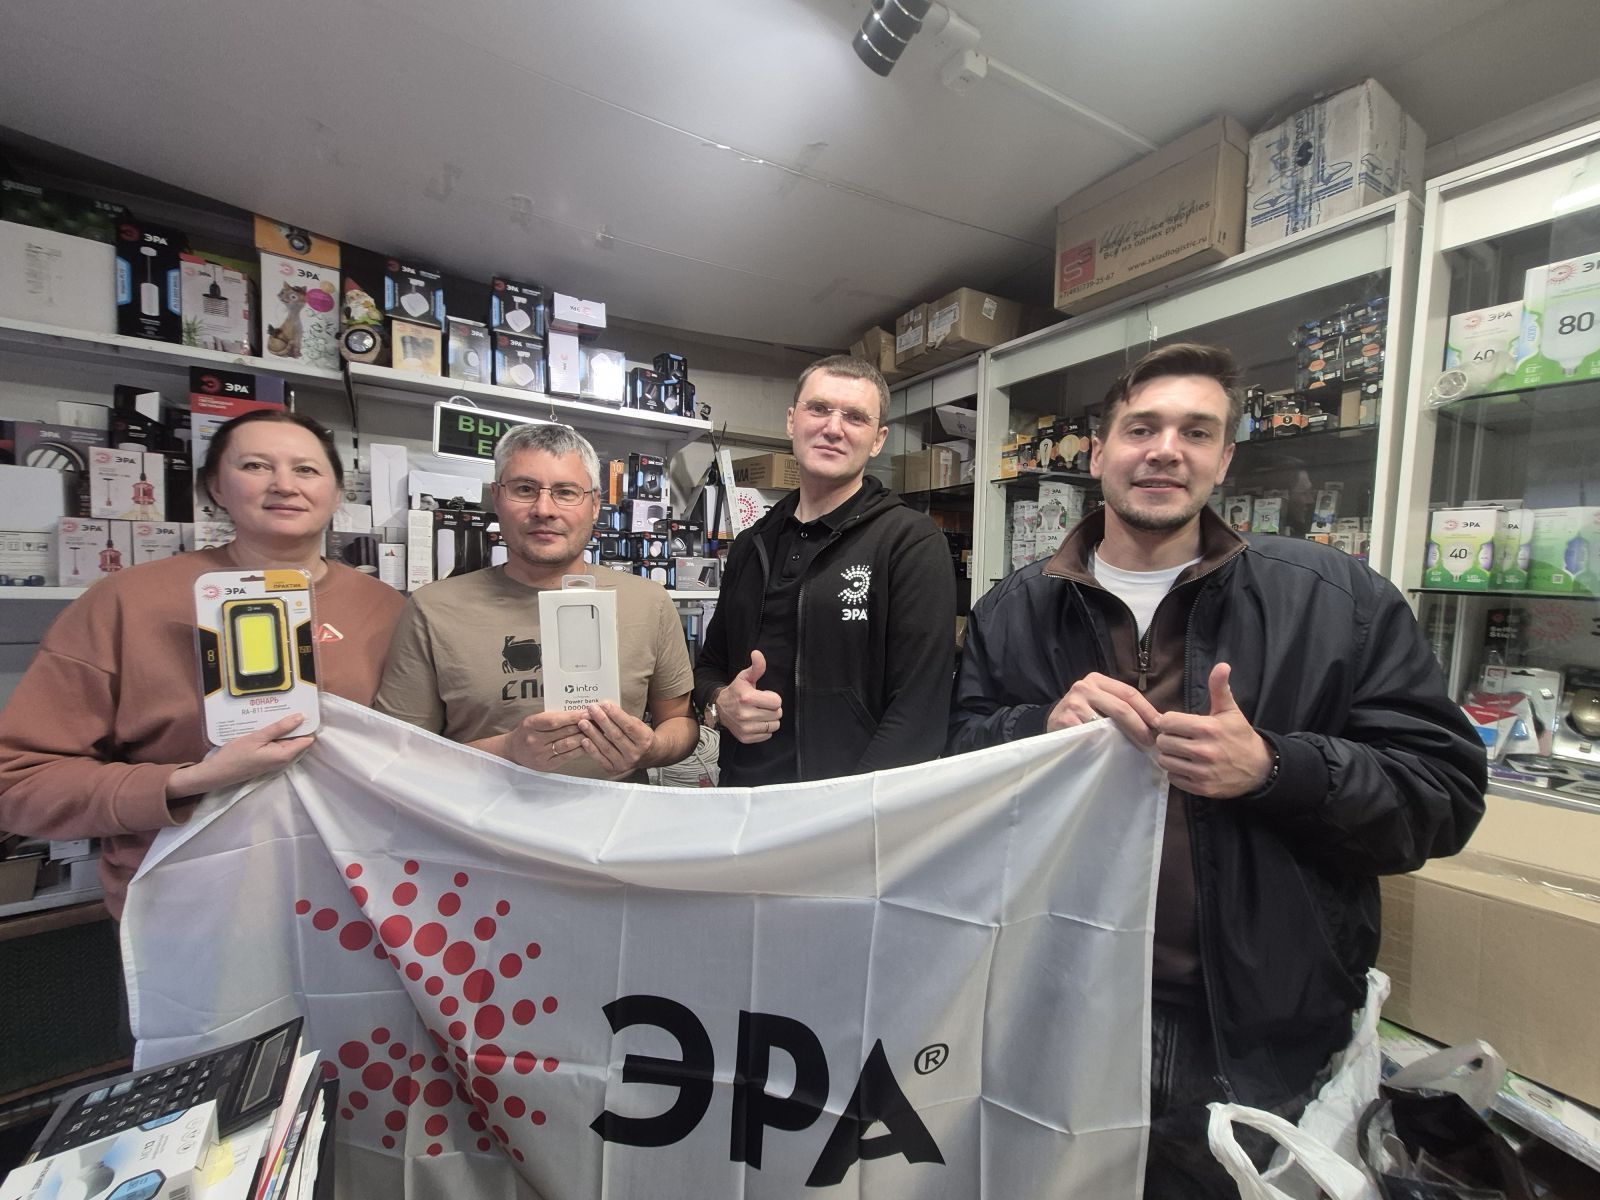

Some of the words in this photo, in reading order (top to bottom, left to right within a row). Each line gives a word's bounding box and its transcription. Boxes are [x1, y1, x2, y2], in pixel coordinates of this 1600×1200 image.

[1133, 222, 1164, 239] Source
[1134, 230, 1162, 247] одних
[1165, 223, 1183, 235] рук
[144, 233, 168, 246] ЭРА
[297, 268, 320, 281] ЭРА
[506, 284, 519, 293] ЭРА
[1487, 311, 1513, 322] ЭРА
[1558, 311, 1595, 335] 80
[471, 330, 484, 338] ЭРА
[510, 339, 522, 347] ЭРА
[224, 382, 249, 393] ЭРА
[40, 430, 60, 439] ЭРА
[115, 456, 136, 464] ЭРА
[612, 463, 621, 472] 10
[81, 524, 103, 532] ЭРА
[155, 527, 174, 535] ЭРА
[1449, 548, 1468, 559] 40
[224, 587, 246, 595] ЭРА
[841, 608, 868, 621] ЭРА
[207, 649, 215, 662] 8
[502, 679, 544, 701] СП
[576, 683, 598, 693] intro
[249, 697, 280, 707] ФОНАРЬ
